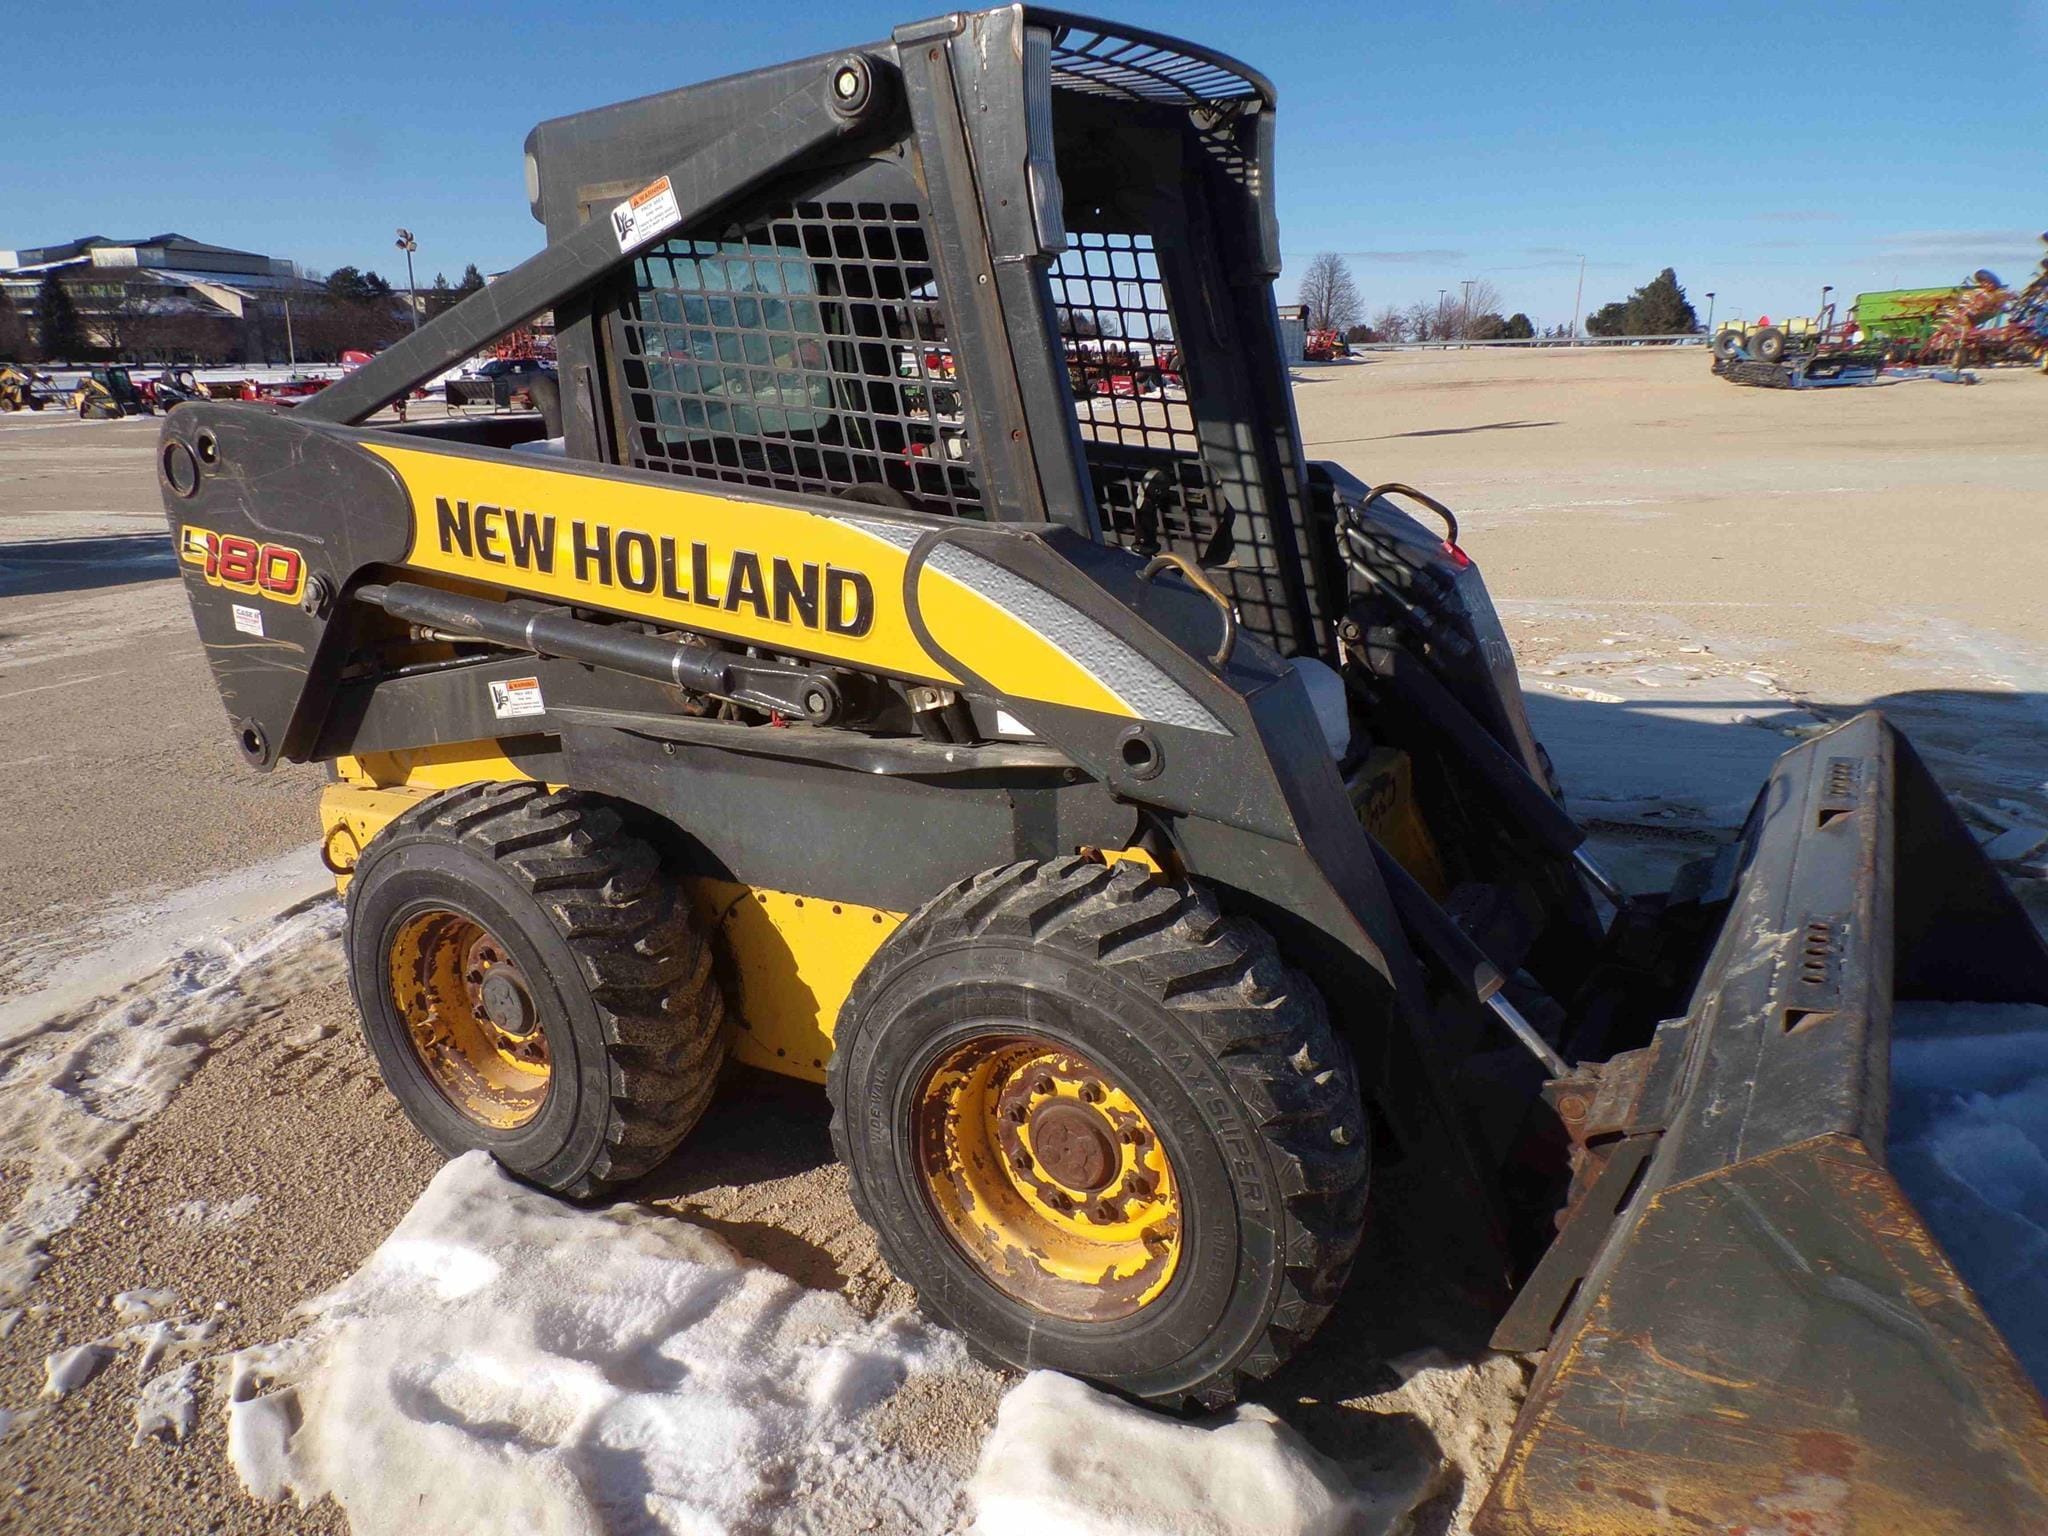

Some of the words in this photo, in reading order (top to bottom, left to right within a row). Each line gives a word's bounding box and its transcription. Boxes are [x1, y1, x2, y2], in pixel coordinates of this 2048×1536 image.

[434, 495, 559, 576] NEW
[571, 519, 877, 639] HOLLAND
[871, 1066, 888, 1104] WALL
[870, 1107, 882, 1145] WIDE
[1206, 1098, 1265, 1203] SUPER
